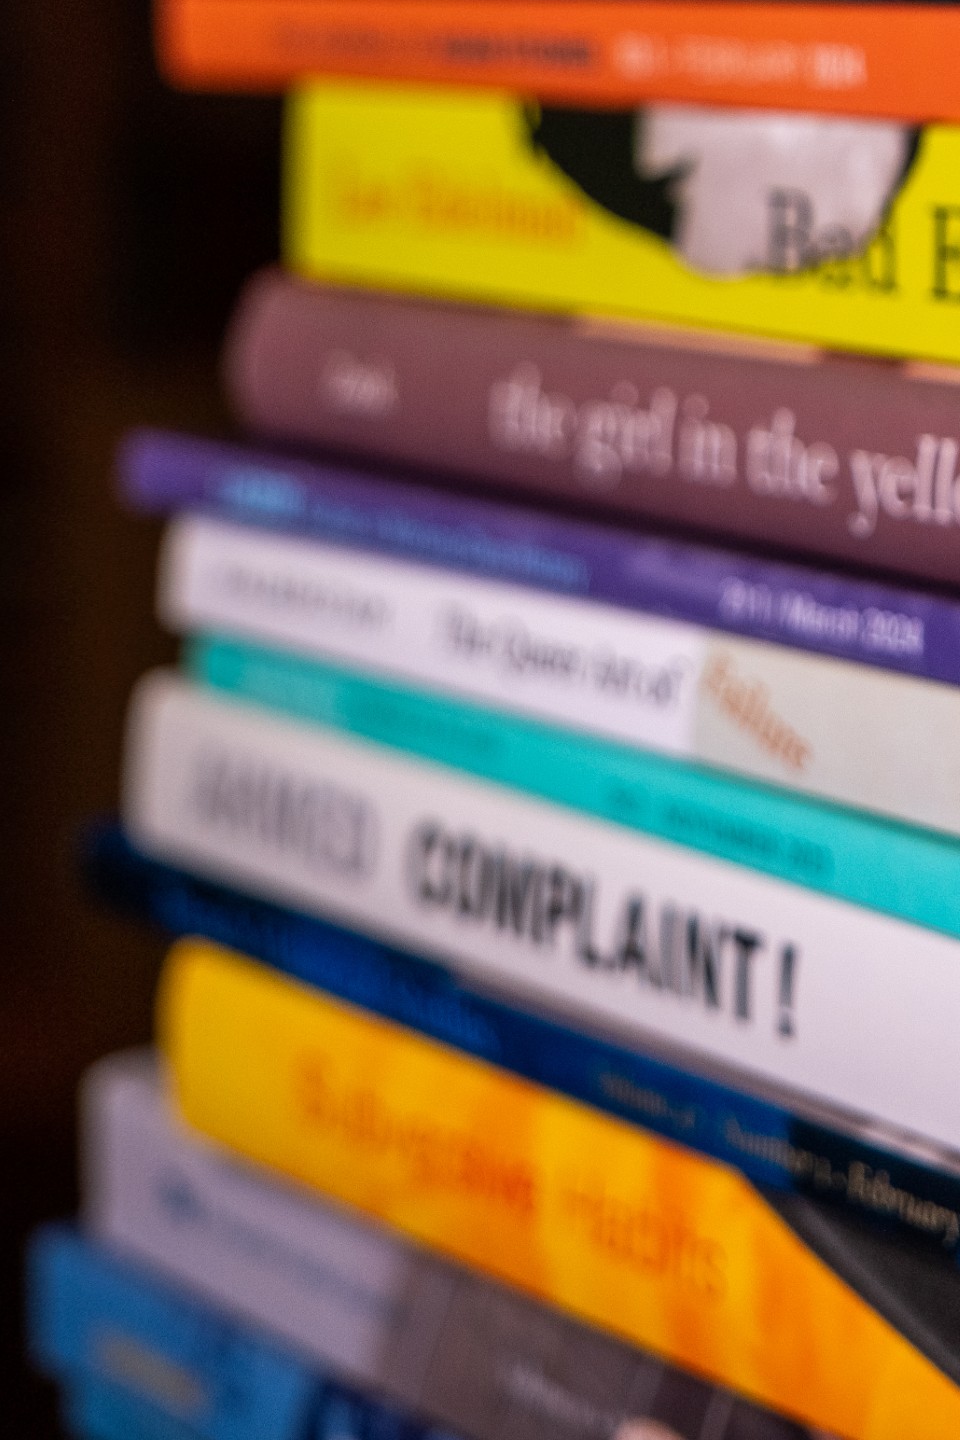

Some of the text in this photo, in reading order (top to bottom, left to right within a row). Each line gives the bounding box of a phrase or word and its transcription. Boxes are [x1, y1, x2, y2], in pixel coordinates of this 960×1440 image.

[762, 187, 900, 298] Bad
[489, 361, 576, 455] the
[679, 393, 737, 488] in
[745, 407, 840, 505] the
